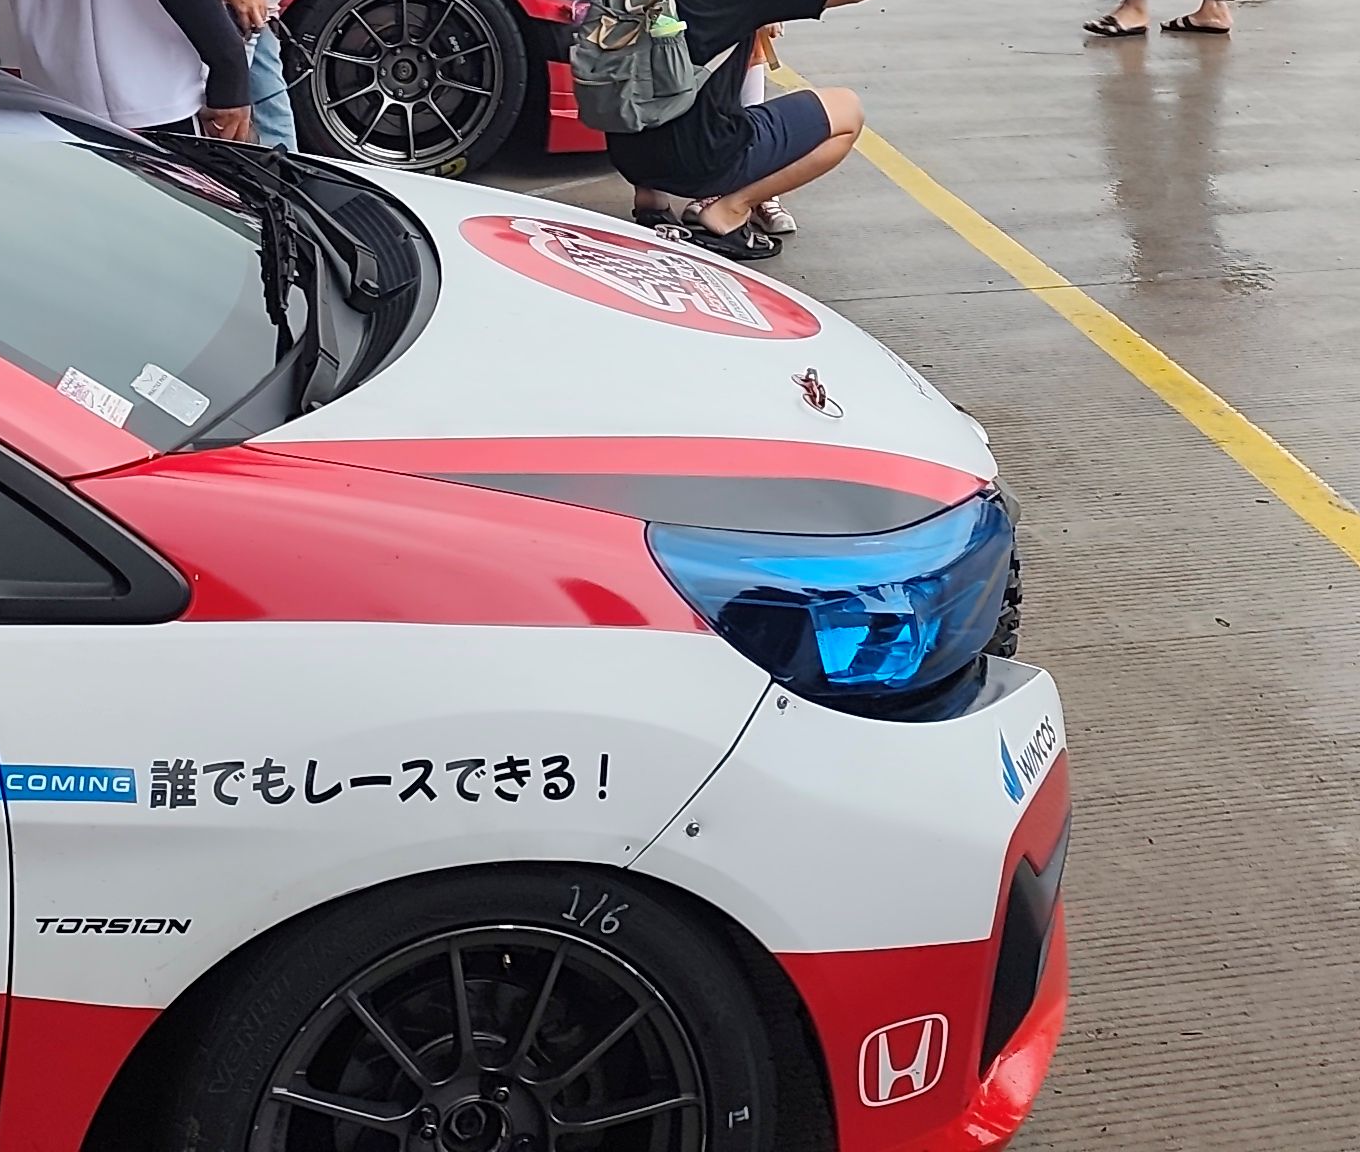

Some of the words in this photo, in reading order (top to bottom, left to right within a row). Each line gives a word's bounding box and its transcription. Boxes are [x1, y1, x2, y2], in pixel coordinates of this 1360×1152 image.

[1018, 717, 1058, 786] WINCOS
[7, 772, 133, 795] COMING
[149, 753, 611, 805] 誰でもレースできる！
[35, 917, 193, 936] TORSION
[567, 884, 624, 937] 1/6
